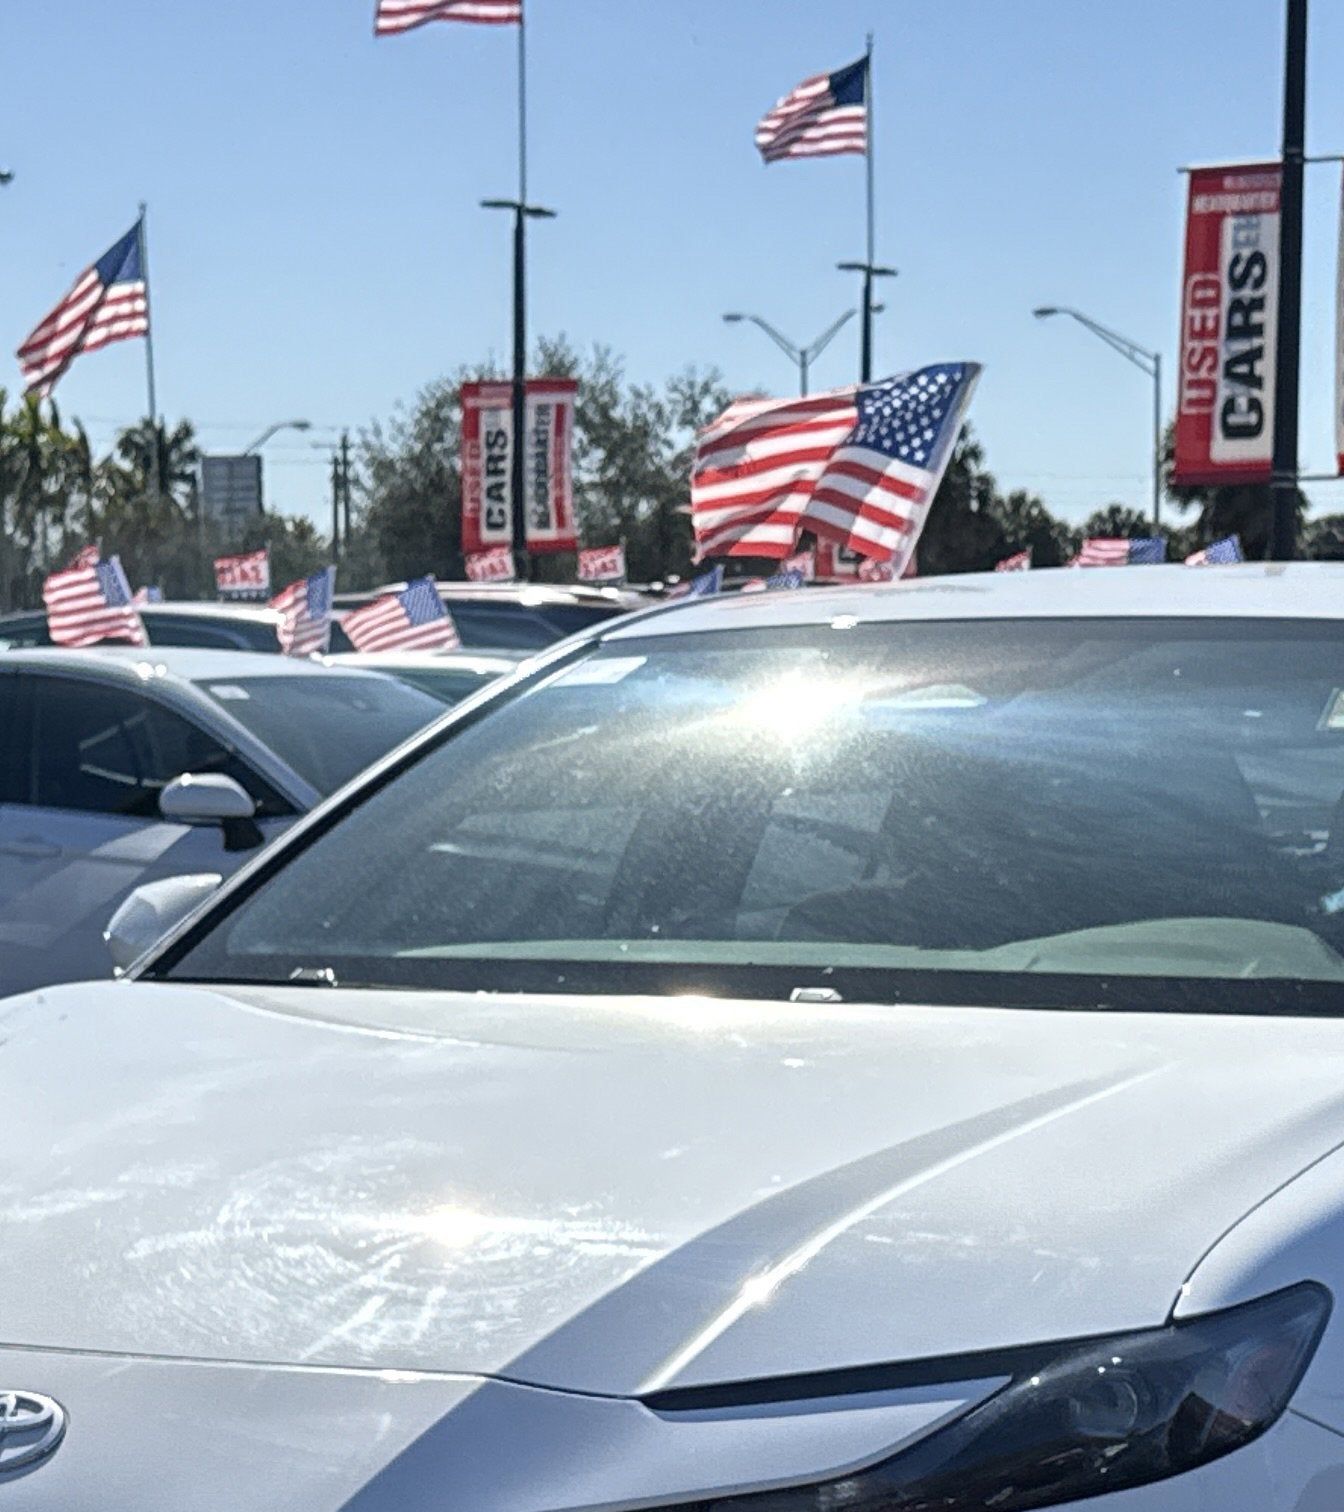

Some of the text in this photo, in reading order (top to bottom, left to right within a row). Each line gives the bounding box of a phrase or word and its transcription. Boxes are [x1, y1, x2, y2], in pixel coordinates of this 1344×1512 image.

[1181, 272, 1222, 414] USED
[1221, 250, 1267, 439] CARS
[485, 429, 507, 530] CARS
